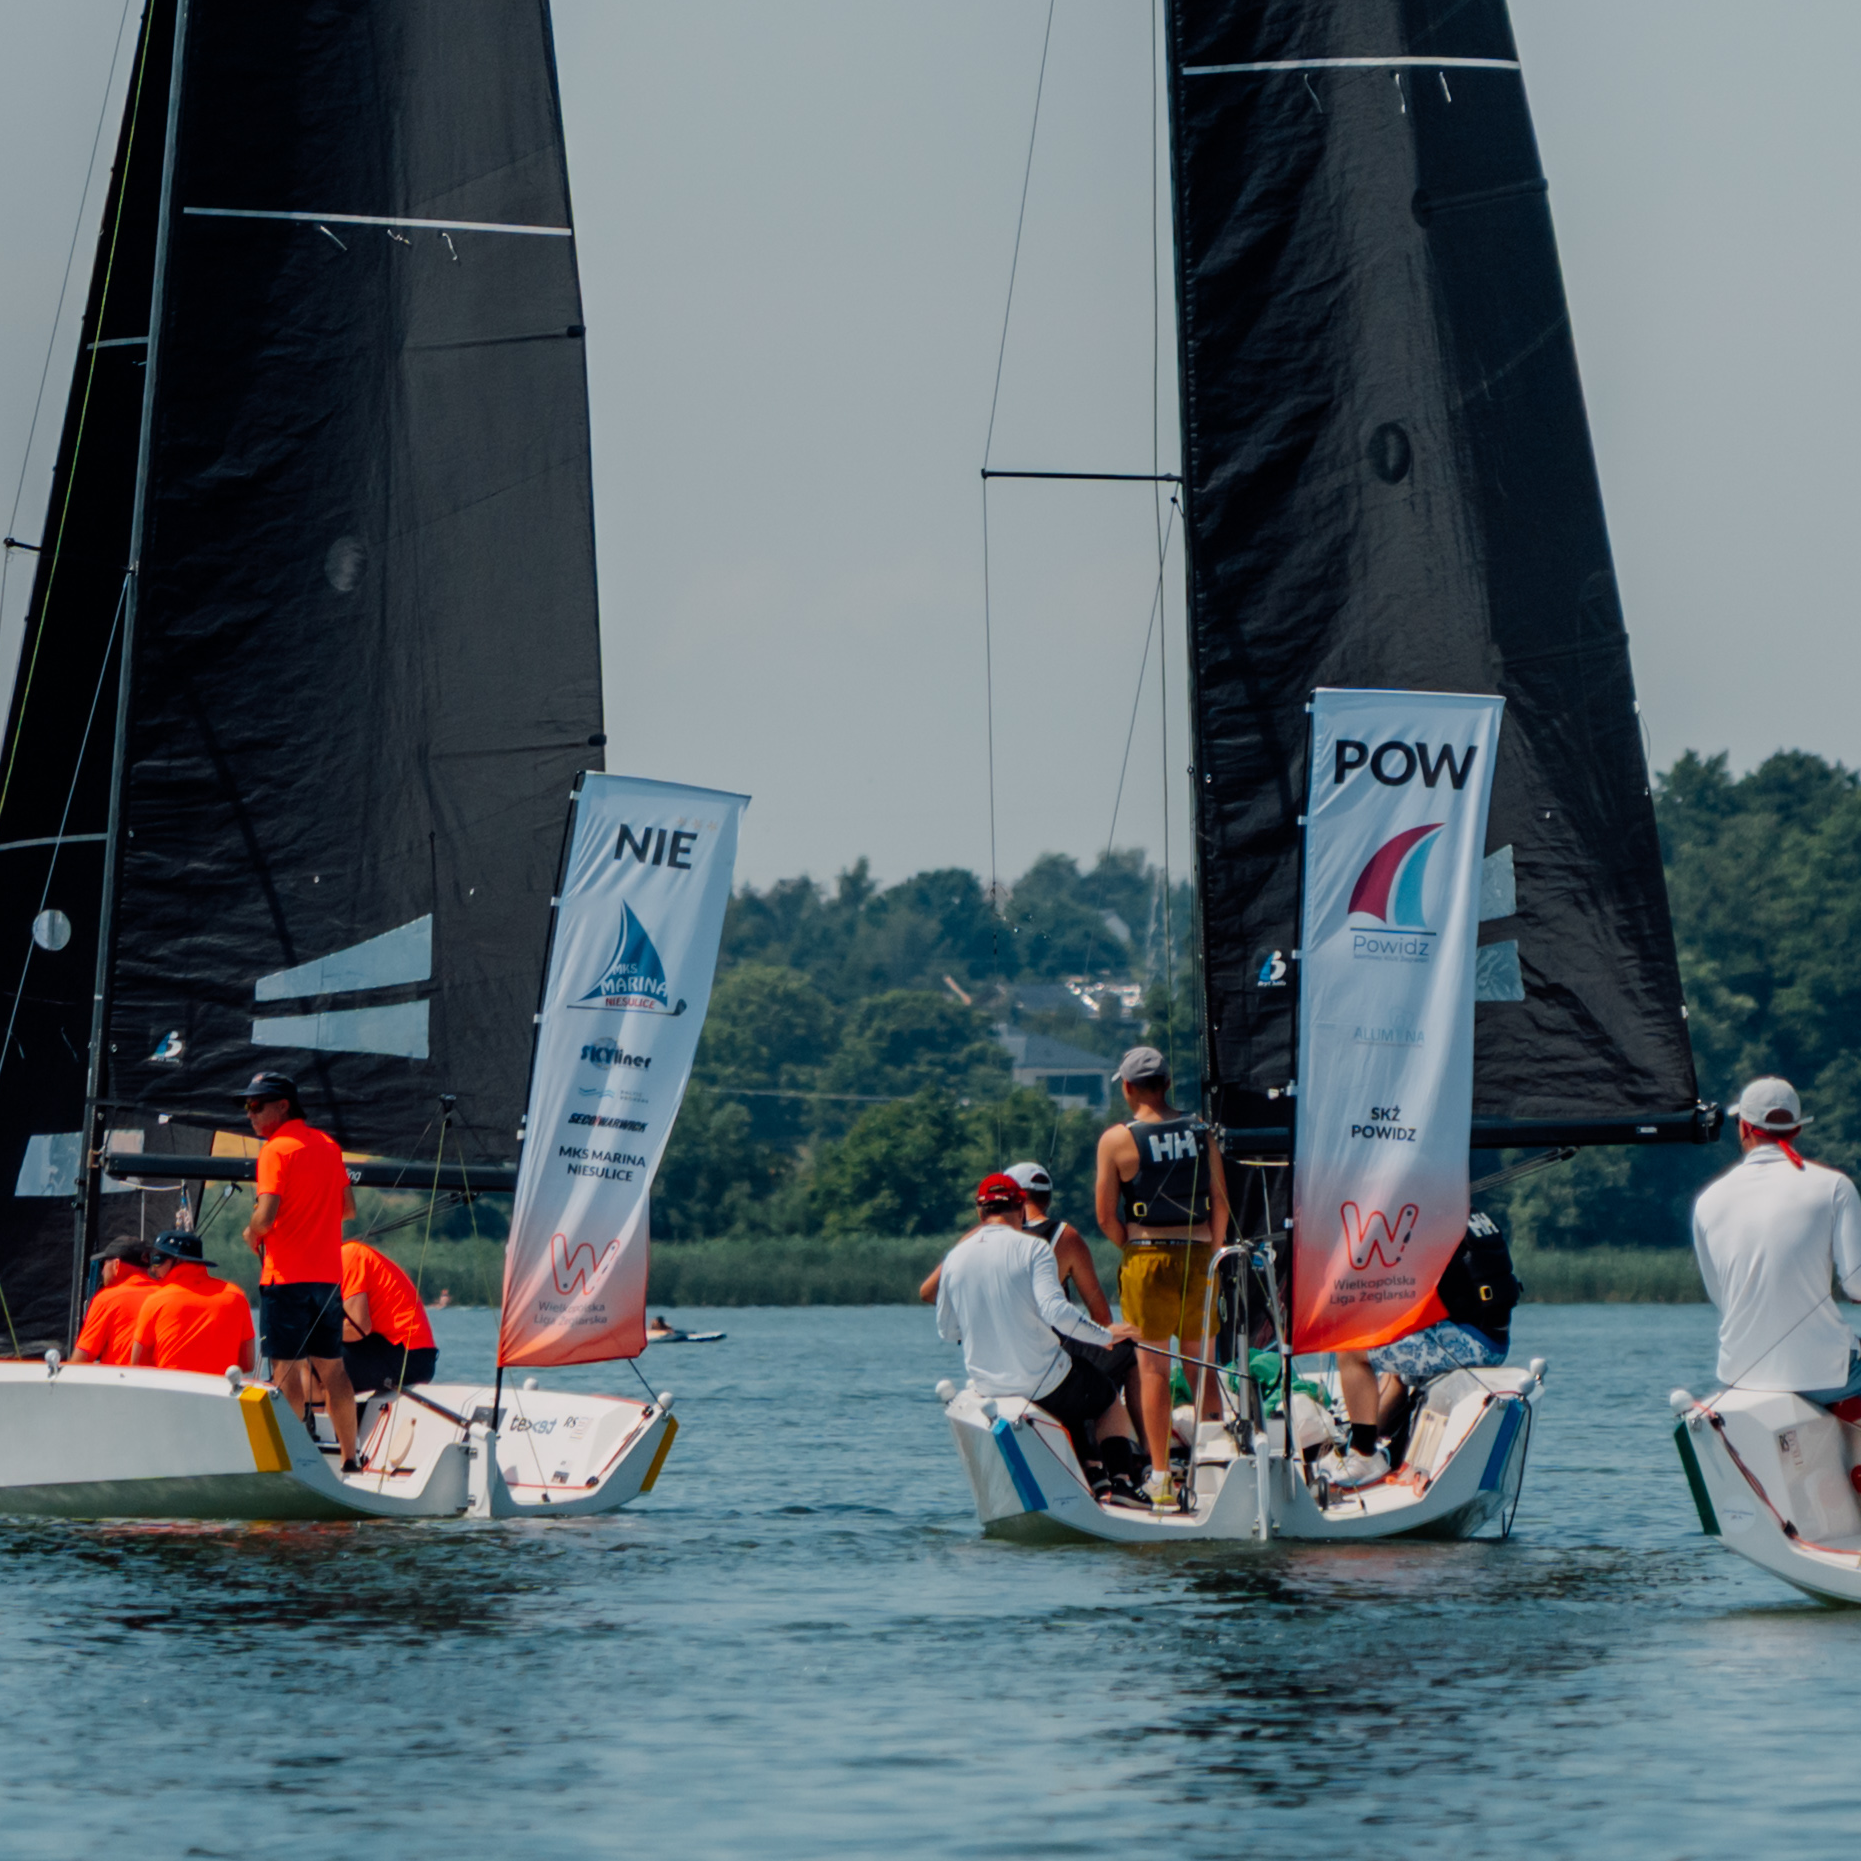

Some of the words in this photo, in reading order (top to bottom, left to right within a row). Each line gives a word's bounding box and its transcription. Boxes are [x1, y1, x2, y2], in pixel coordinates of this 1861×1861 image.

[1334, 739, 1479, 790] POW
[614, 823, 698, 870] NIE
[1353, 935, 1429, 956] Powidz
[612, 962, 638, 975] MKS
[600, 976, 669, 996] MARINA
[605, 997, 655, 1009] NIESULICE
[1371, 1105, 1401, 1121] SKŻ
[1351, 1124, 1416, 1142] POWIDZ
[1149, 1130, 1199, 1162] HH
[559, 1145, 589, 1160] MKS
[591, 1148, 646, 1168] MARINA
[567, 1163, 634, 1182] NIESULICE
[1334, 1276, 1416, 1291] Wielkopolska
[1330, 1293, 1356, 1307] Liga
